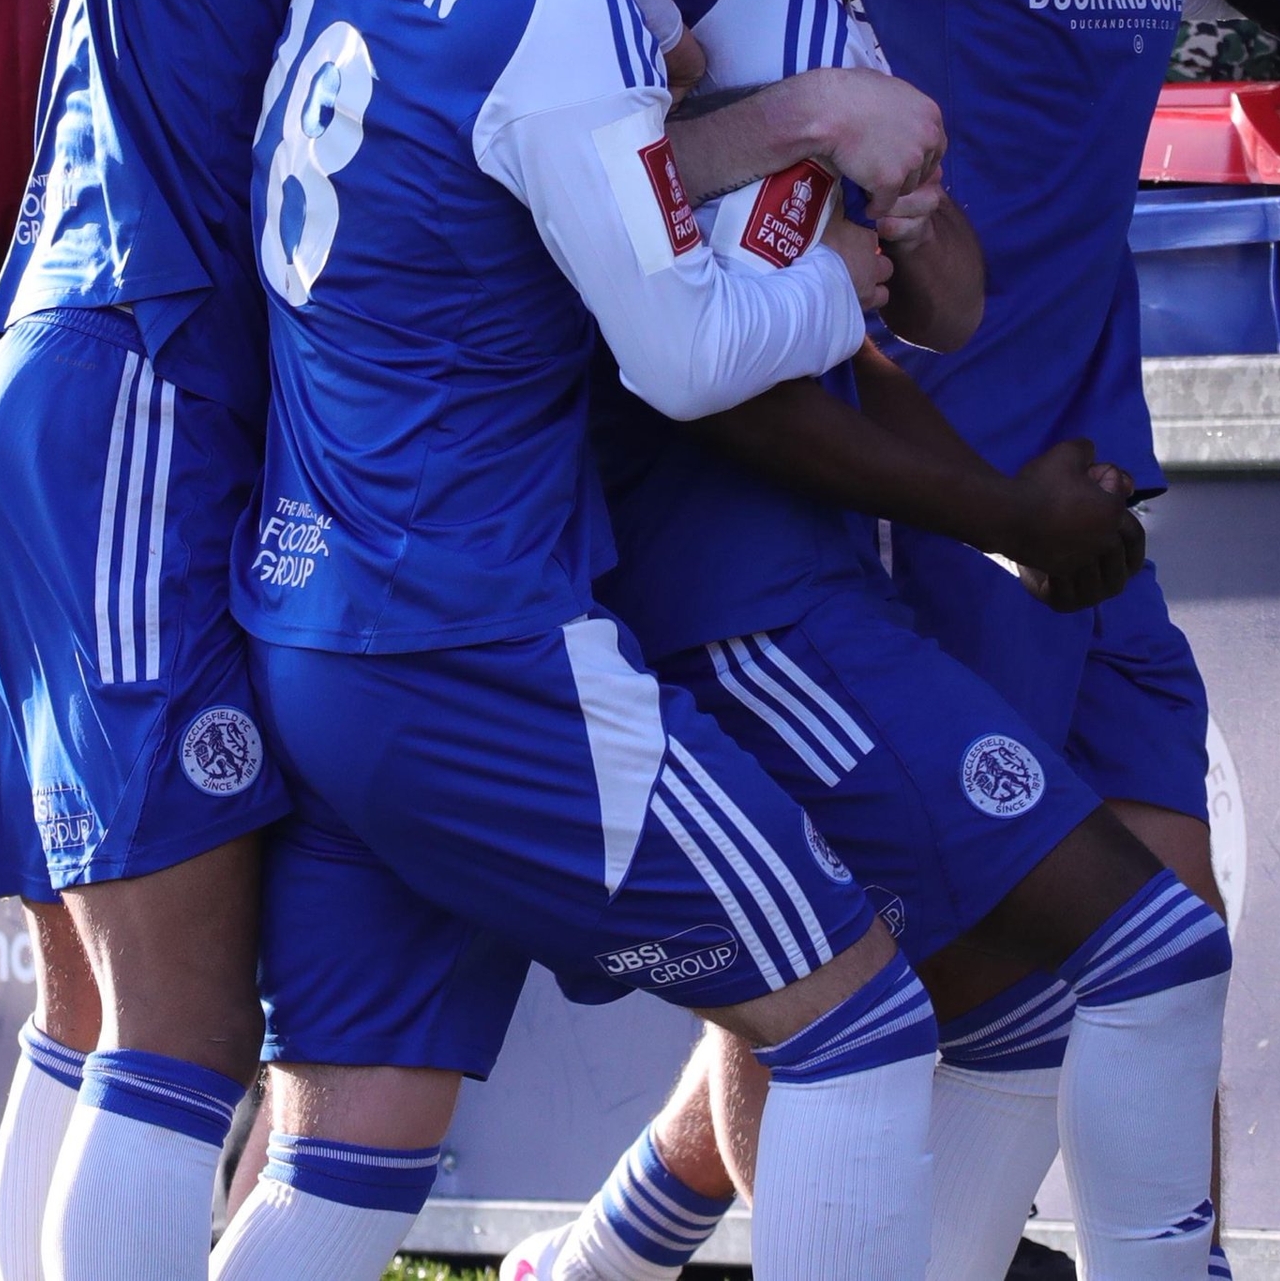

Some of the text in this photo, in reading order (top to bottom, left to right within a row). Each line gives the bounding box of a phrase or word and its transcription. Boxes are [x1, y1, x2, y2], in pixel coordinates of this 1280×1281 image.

[756, 227, 799, 260] FA CUP
[762, 213, 805, 246] Emirates
[276, 497, 298, 516] THE
[251, 549, 315, 588] GROUP
[184, 711, 252, 758] MACCLESFIELD FC
[201, 758, 258, 792] SINCE 1874
[964, 739, 1021, 793] MACCLESFIELD FC
[995, 799, 1026, 813] SINCE
[1209, 762, 1233, 818] FC
[606, 943, 668, 974] JBSi
[650, 947, 732, 985] GROUP
